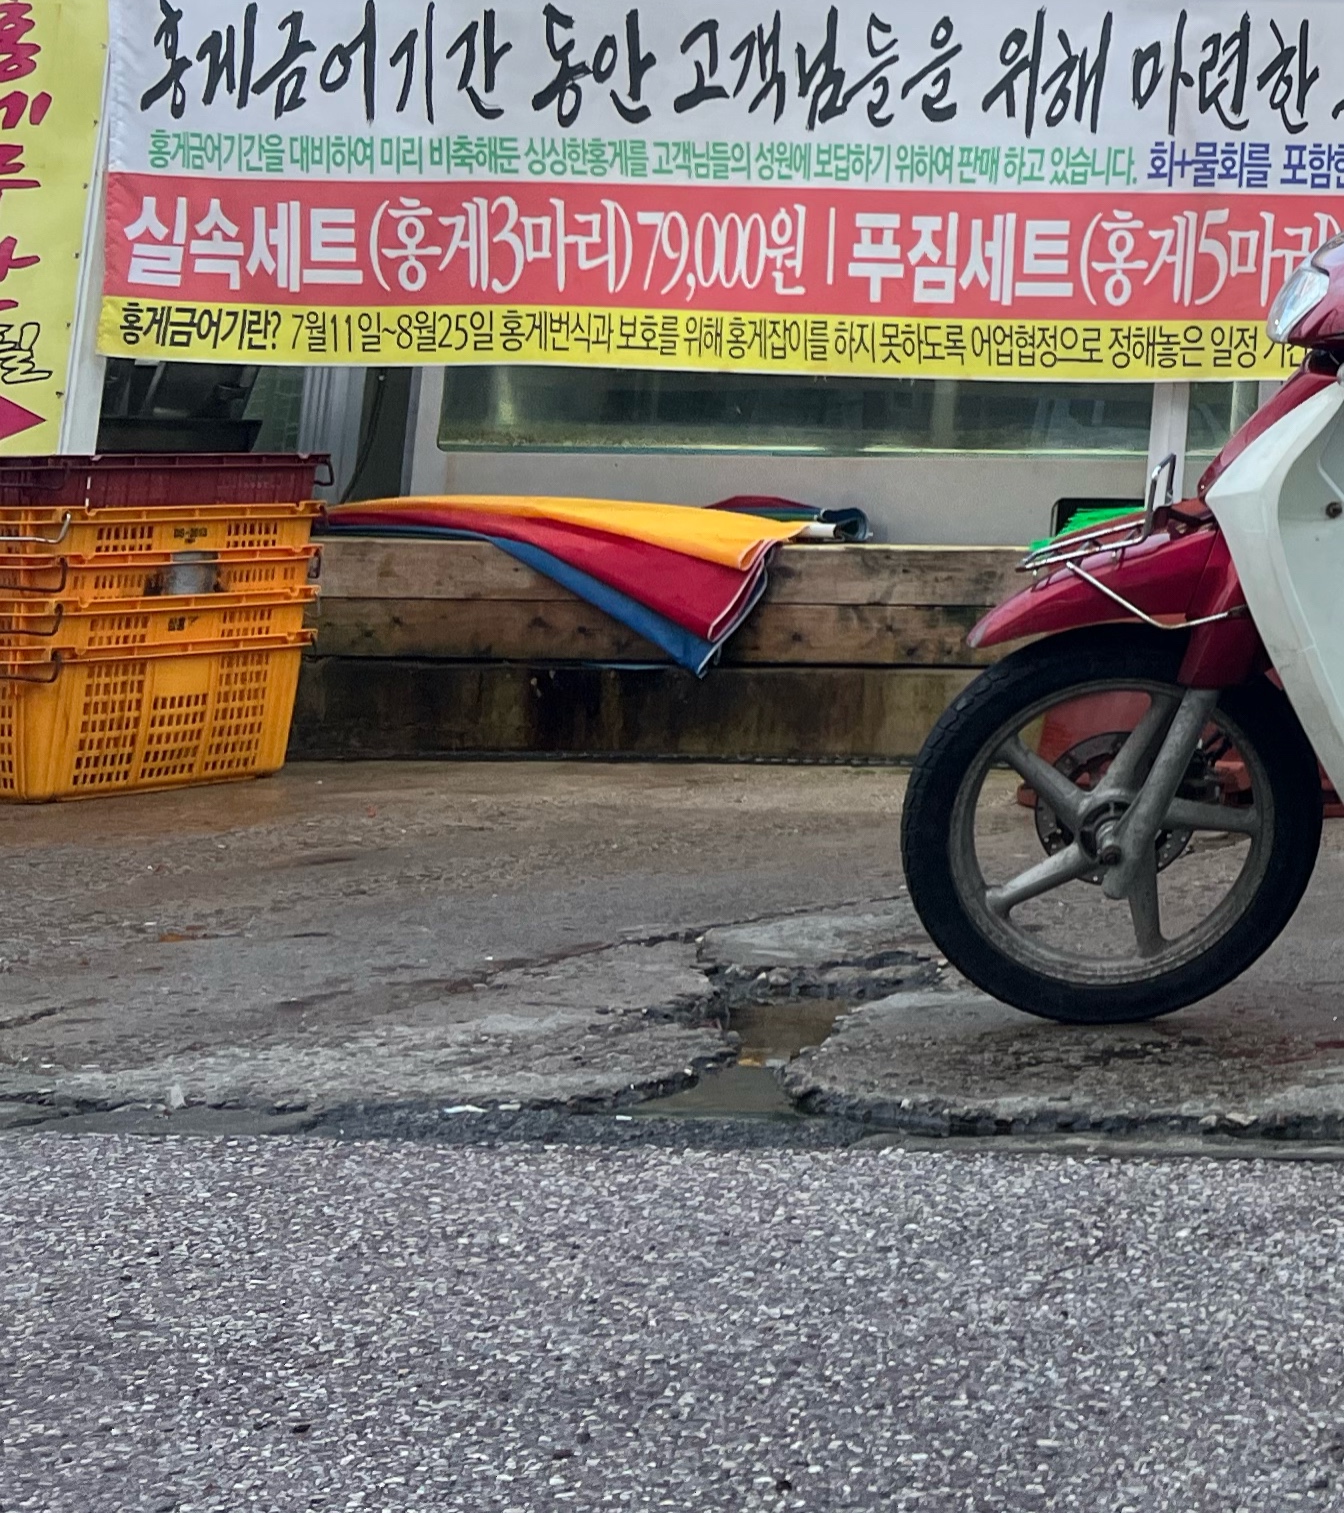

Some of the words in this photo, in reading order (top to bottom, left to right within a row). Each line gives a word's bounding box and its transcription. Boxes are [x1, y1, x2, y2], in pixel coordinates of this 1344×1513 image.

[532, 2, 656, 129] 동안
[674, 5, 963, 131] 고객님들을
[982, 6, 1113, 139] 위해
[1130, 8, 1320, 136] 마련한
[148, 128, 286, 173] 홍게금어기간을
[290, 134, 375, 175] 대비하여
[381, 135, 423, 175] 미리
[430, 135, 520, 176] 비축해둔
[652, 139, 752, 180] 고객님들의
[755, 141, 810, 181] 성원에
[814, 142, 892, 182] 보답하기
[895, 143, 955, 184] 위하여
[957, 145, 1001, 185] 판매
[1004, 145, 1045, 185] 하고
[1049, 145, 1138, 186] 있습니다.
[119, 301, 282, 350] 홍게금어기란?
[499, 309, 614, 354] 홍게번식과
[616, 314, 680, 356] 보호를
[684, 315, 724, 358] 위해
[727, 317, 830, 363] 홍게잡이를
[834, 320, 876, 364] 하지
[879, 322, 967, 366] 못하도록
[970, 324, 1104, 368] 어업협정으로
[1107, 324, 1203, 369] 정해놓은
[1210, 324, 1259, 369] 일정
